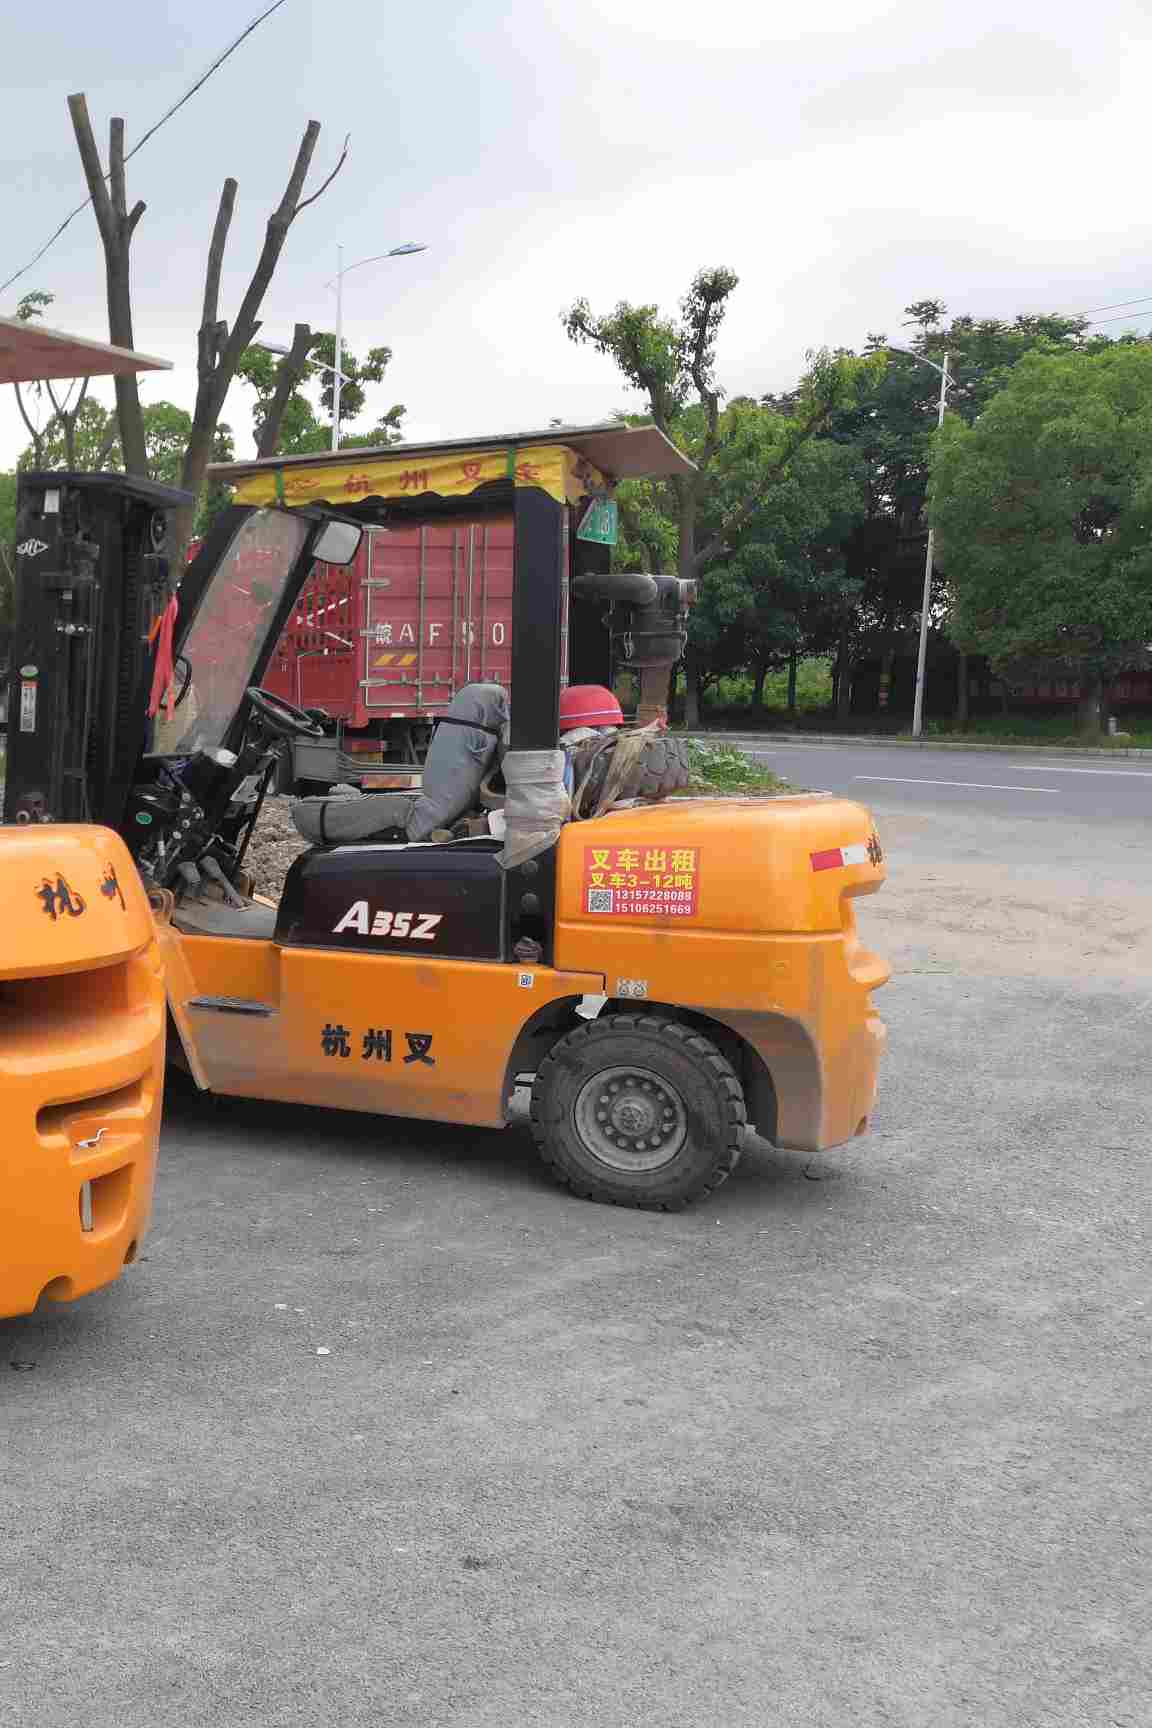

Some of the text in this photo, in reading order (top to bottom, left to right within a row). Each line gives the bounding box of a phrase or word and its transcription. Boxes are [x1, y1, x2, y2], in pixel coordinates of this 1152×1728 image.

[343, 460, 542, 496] 杭州叉车
[589, 848, 696, 872] 叉车出租
[589, 872, 694, 889] 叉车3-12吨
[331, 900, 444, 940] A35Z
[615, 903, 691, 915] 15106251669
[320, 1023, 436, 1068] 杭州叉
